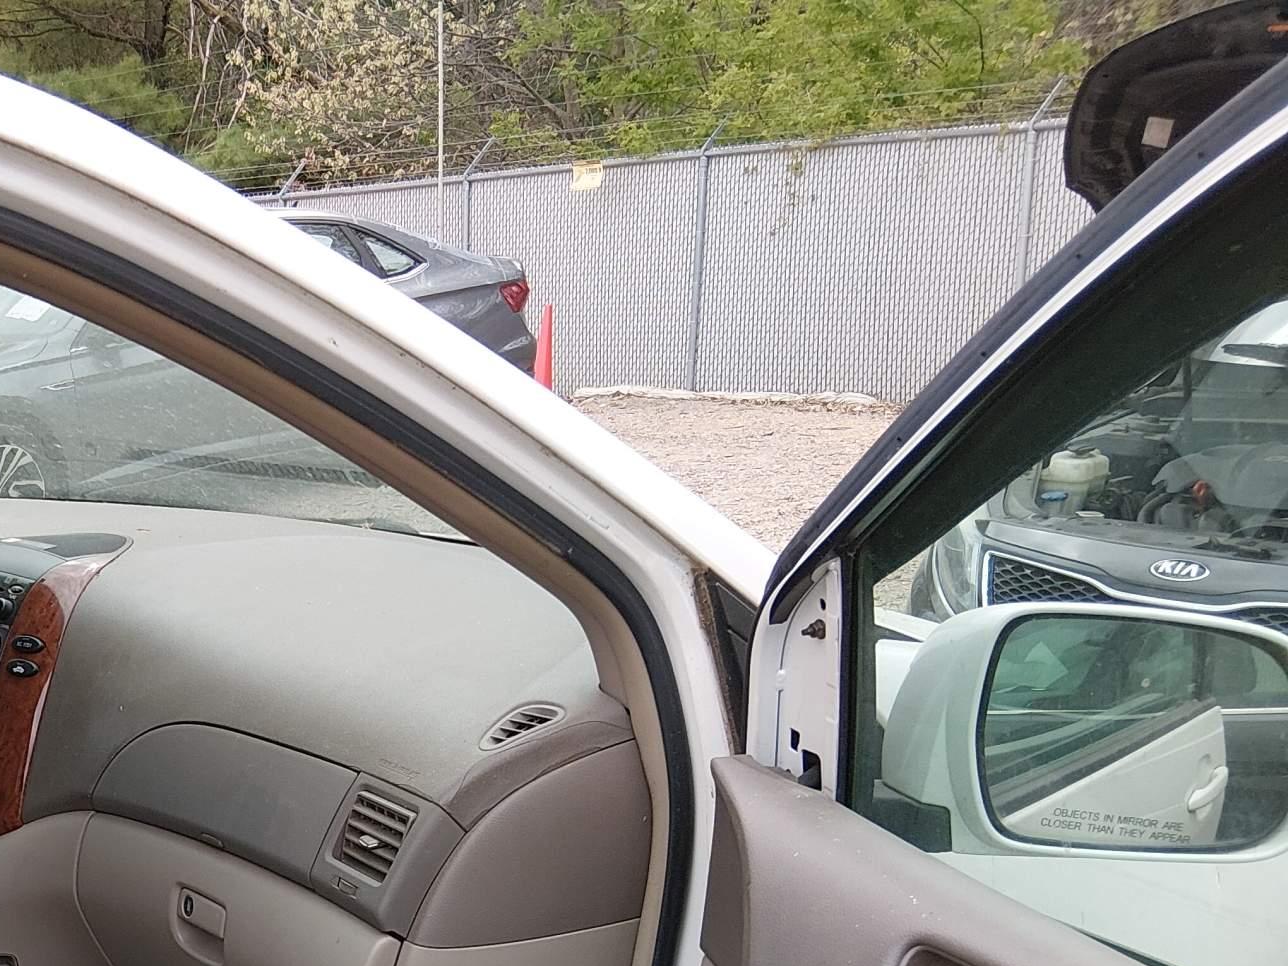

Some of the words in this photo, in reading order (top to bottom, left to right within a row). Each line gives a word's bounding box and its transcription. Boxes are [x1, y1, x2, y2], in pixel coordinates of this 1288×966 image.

[1157, 560, 1200, 577] KIA
[1040, 817, 1082, 830] CLOSER
[1087, 823, 1113, 834] THAN
[1118, 827, 1145, 838] THEY
[1148, 831, 1191, 844] APPEAR
[1052, 807, 1100, 821] OBJECTS
[1103, 814, 1114, 823] IN
[1116, 815, 1158, 828] MIRROR
[1161, 821, 1184, 832] ARE
